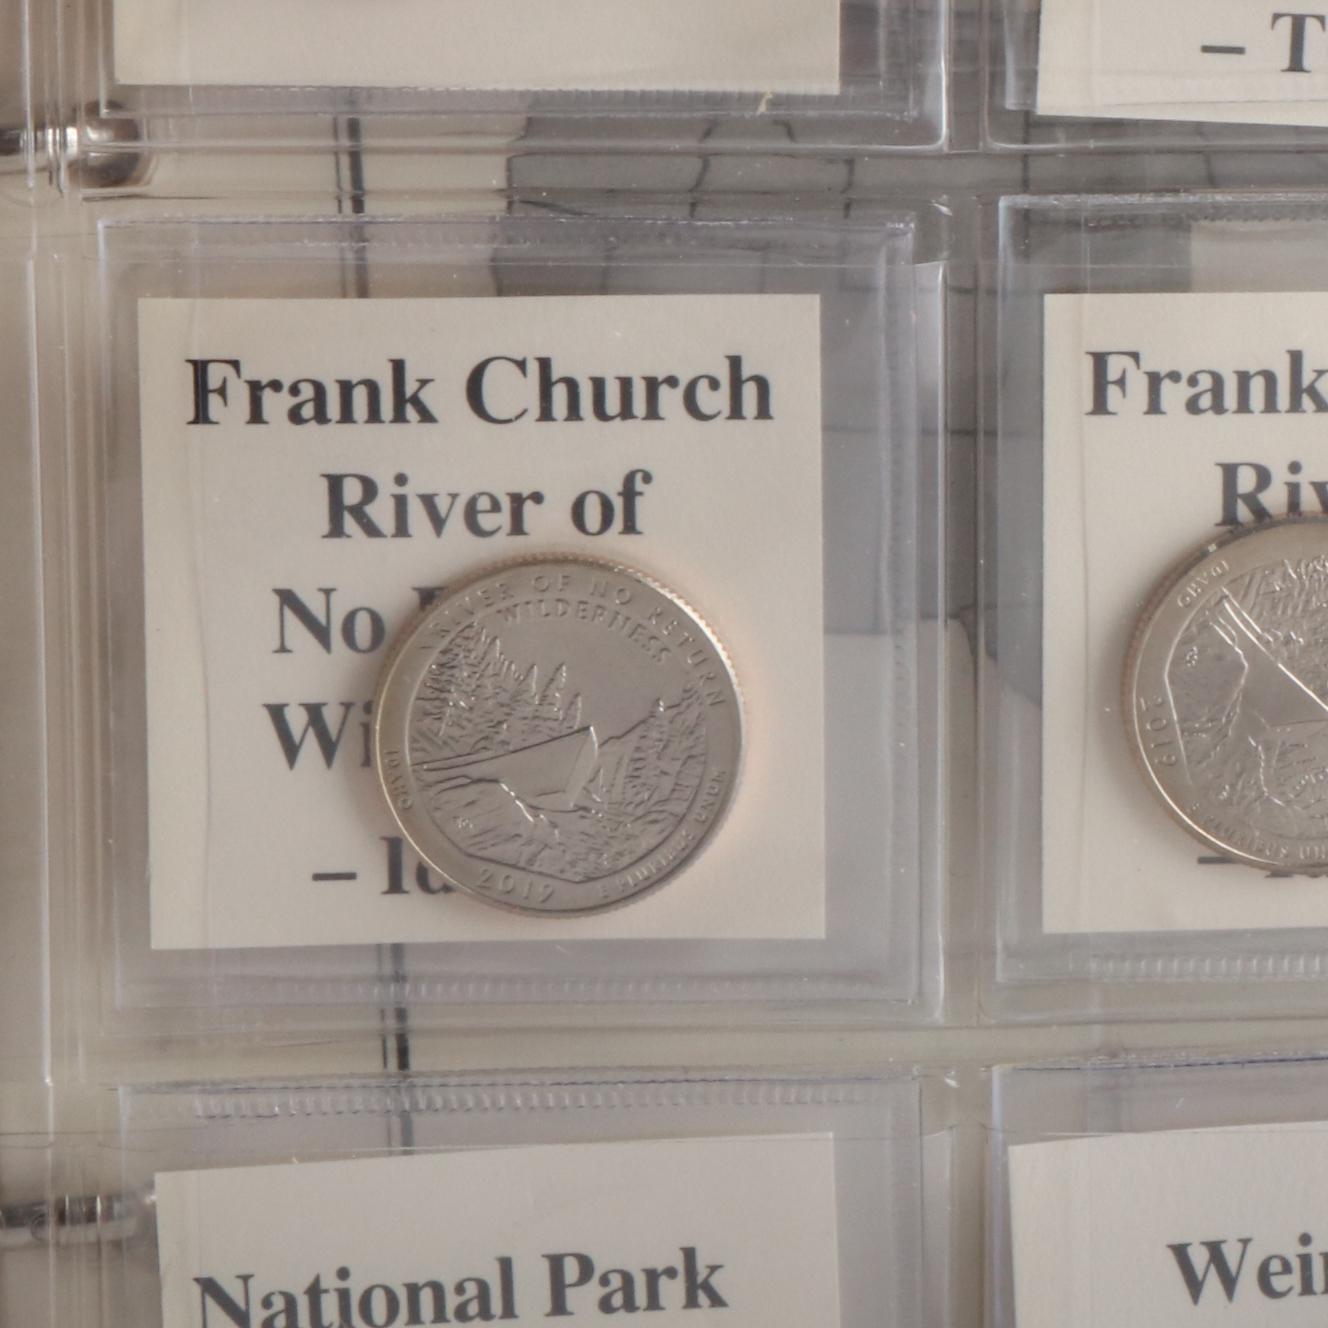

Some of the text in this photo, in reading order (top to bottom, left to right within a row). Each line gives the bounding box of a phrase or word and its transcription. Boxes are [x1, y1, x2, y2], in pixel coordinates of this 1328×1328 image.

[184, 354, 774, 426] Frank Church
[320, 468, 654, 539] River of
[271, 587, 387, 654] No
[477, 869, 556, 903] 2019
[192, 1245, 729, 1328] National Park
